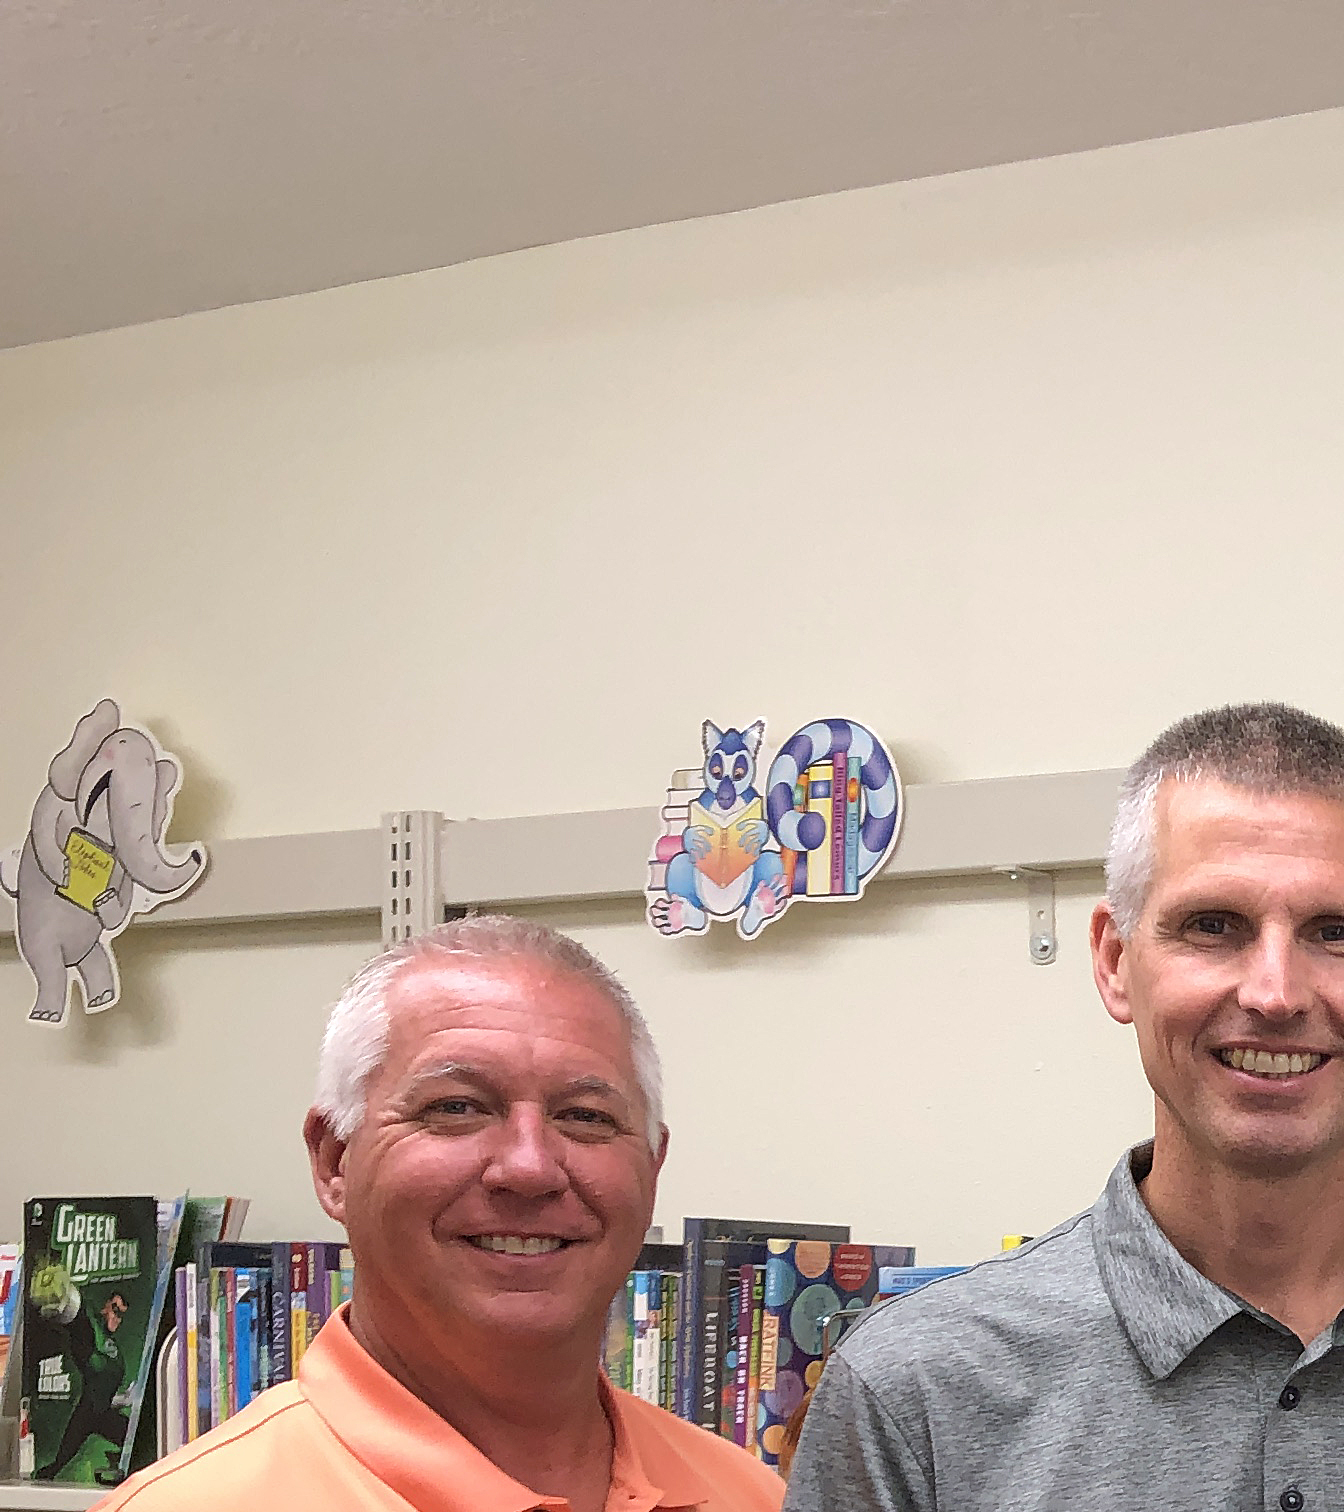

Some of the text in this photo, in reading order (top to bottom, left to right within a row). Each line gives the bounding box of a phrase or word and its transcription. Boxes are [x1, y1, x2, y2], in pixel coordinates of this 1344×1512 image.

[57, 1205, 116, 1242] GREEN
[67, 1242, 138, 1281] LANTERN
[272, 1291, 285, 1384] CARNIVAL
